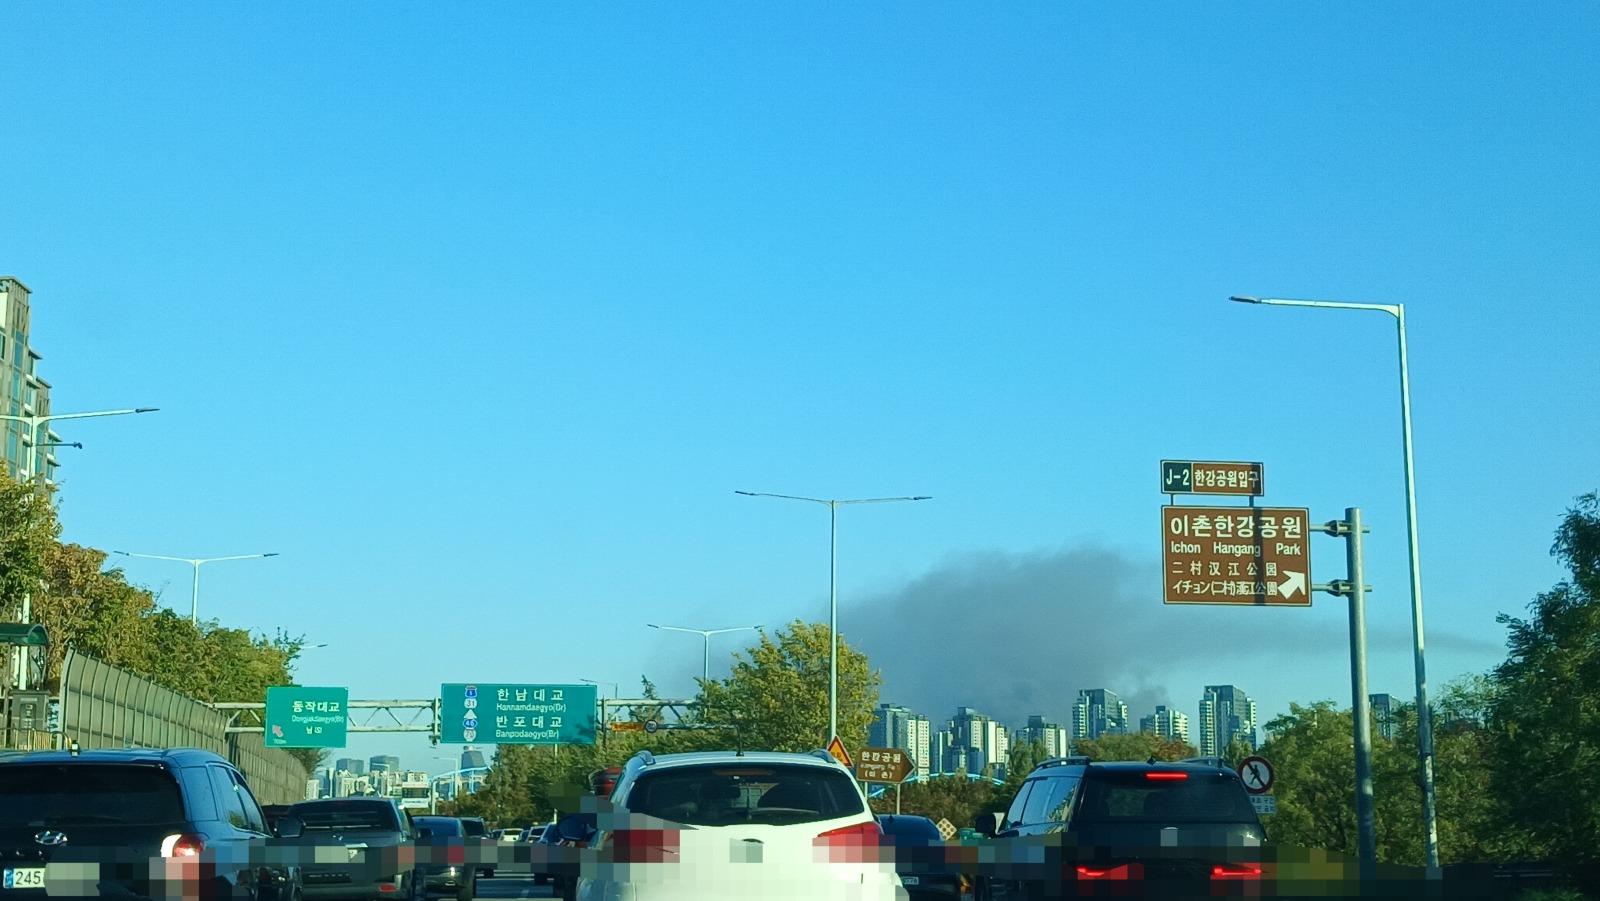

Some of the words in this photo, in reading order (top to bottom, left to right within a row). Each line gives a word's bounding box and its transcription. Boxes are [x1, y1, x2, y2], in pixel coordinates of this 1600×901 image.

[1166, 469, 1190, 486] J-2
[1194, 470, 1259, 488] 한강공원입구
[1170, 514, 1302, 539] 이촌한강공원
[1171, 541, 1201, 554] Ichon
[1213, 542, 1261, 557] Hangang
[1275, 543, 1301, 556] Park
[497, 688, 564, 702] 한남대교
[292, 700, 340, 713] 동작대교
[496, 703, 567, 713] Hannamdaegyo(Br)
[496, 715, 562, 728] 반포대교
[495, 729, 559, 739] Banpodaegyo(Br)
[861, 751, 901, 763] 한강공원
[16, 871, 41, 885] 245
